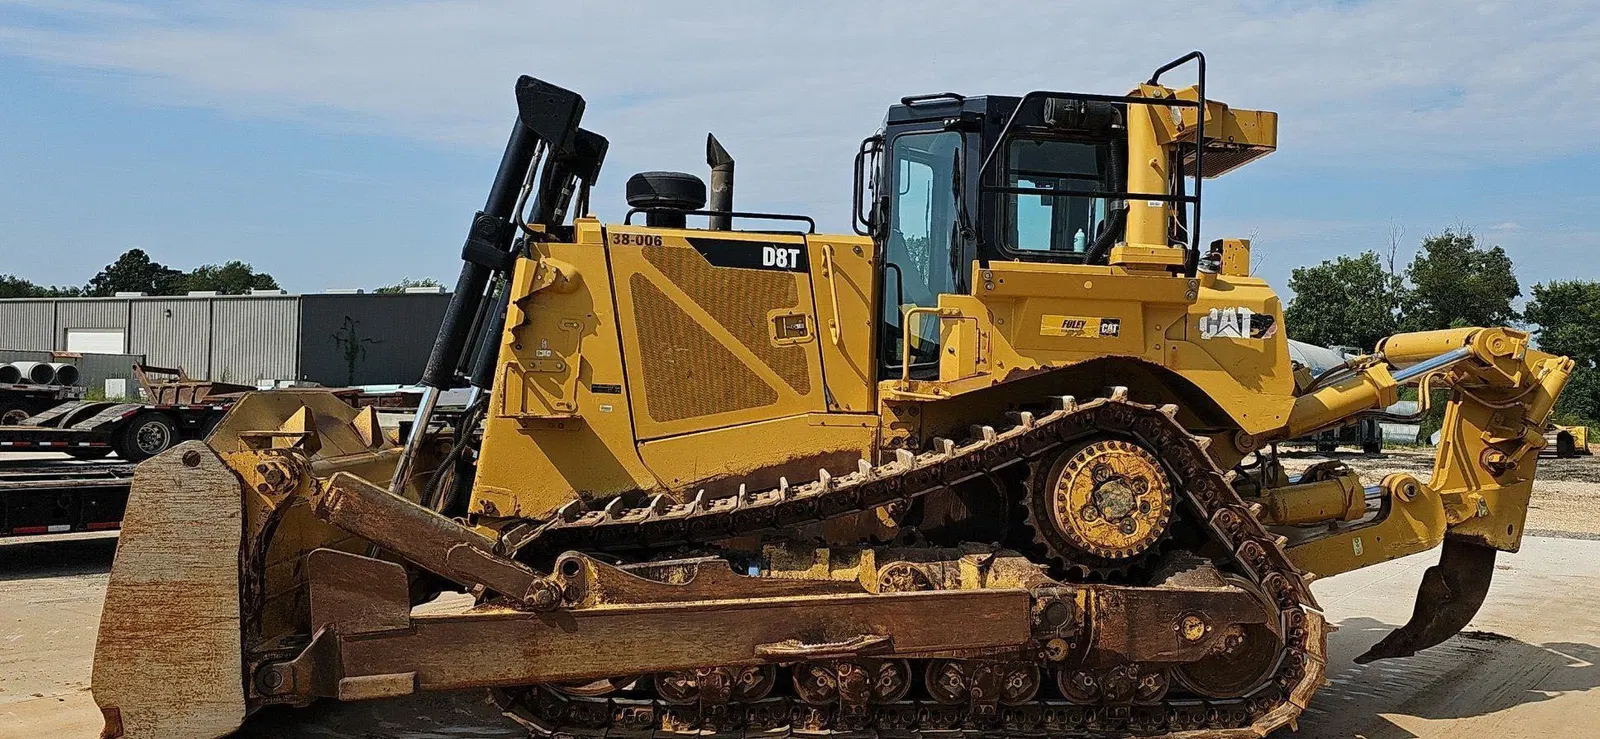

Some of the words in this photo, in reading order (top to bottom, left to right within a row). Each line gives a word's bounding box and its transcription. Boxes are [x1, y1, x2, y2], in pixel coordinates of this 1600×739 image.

[613, 233, 662, 246] 38-006
[762, 246, 800, 269] D8T
[1062, 319, 1087, 329] FOLEY
[1101, 323, 1118, 334] CAT
[1200, 306, 1256, 340] CAT
